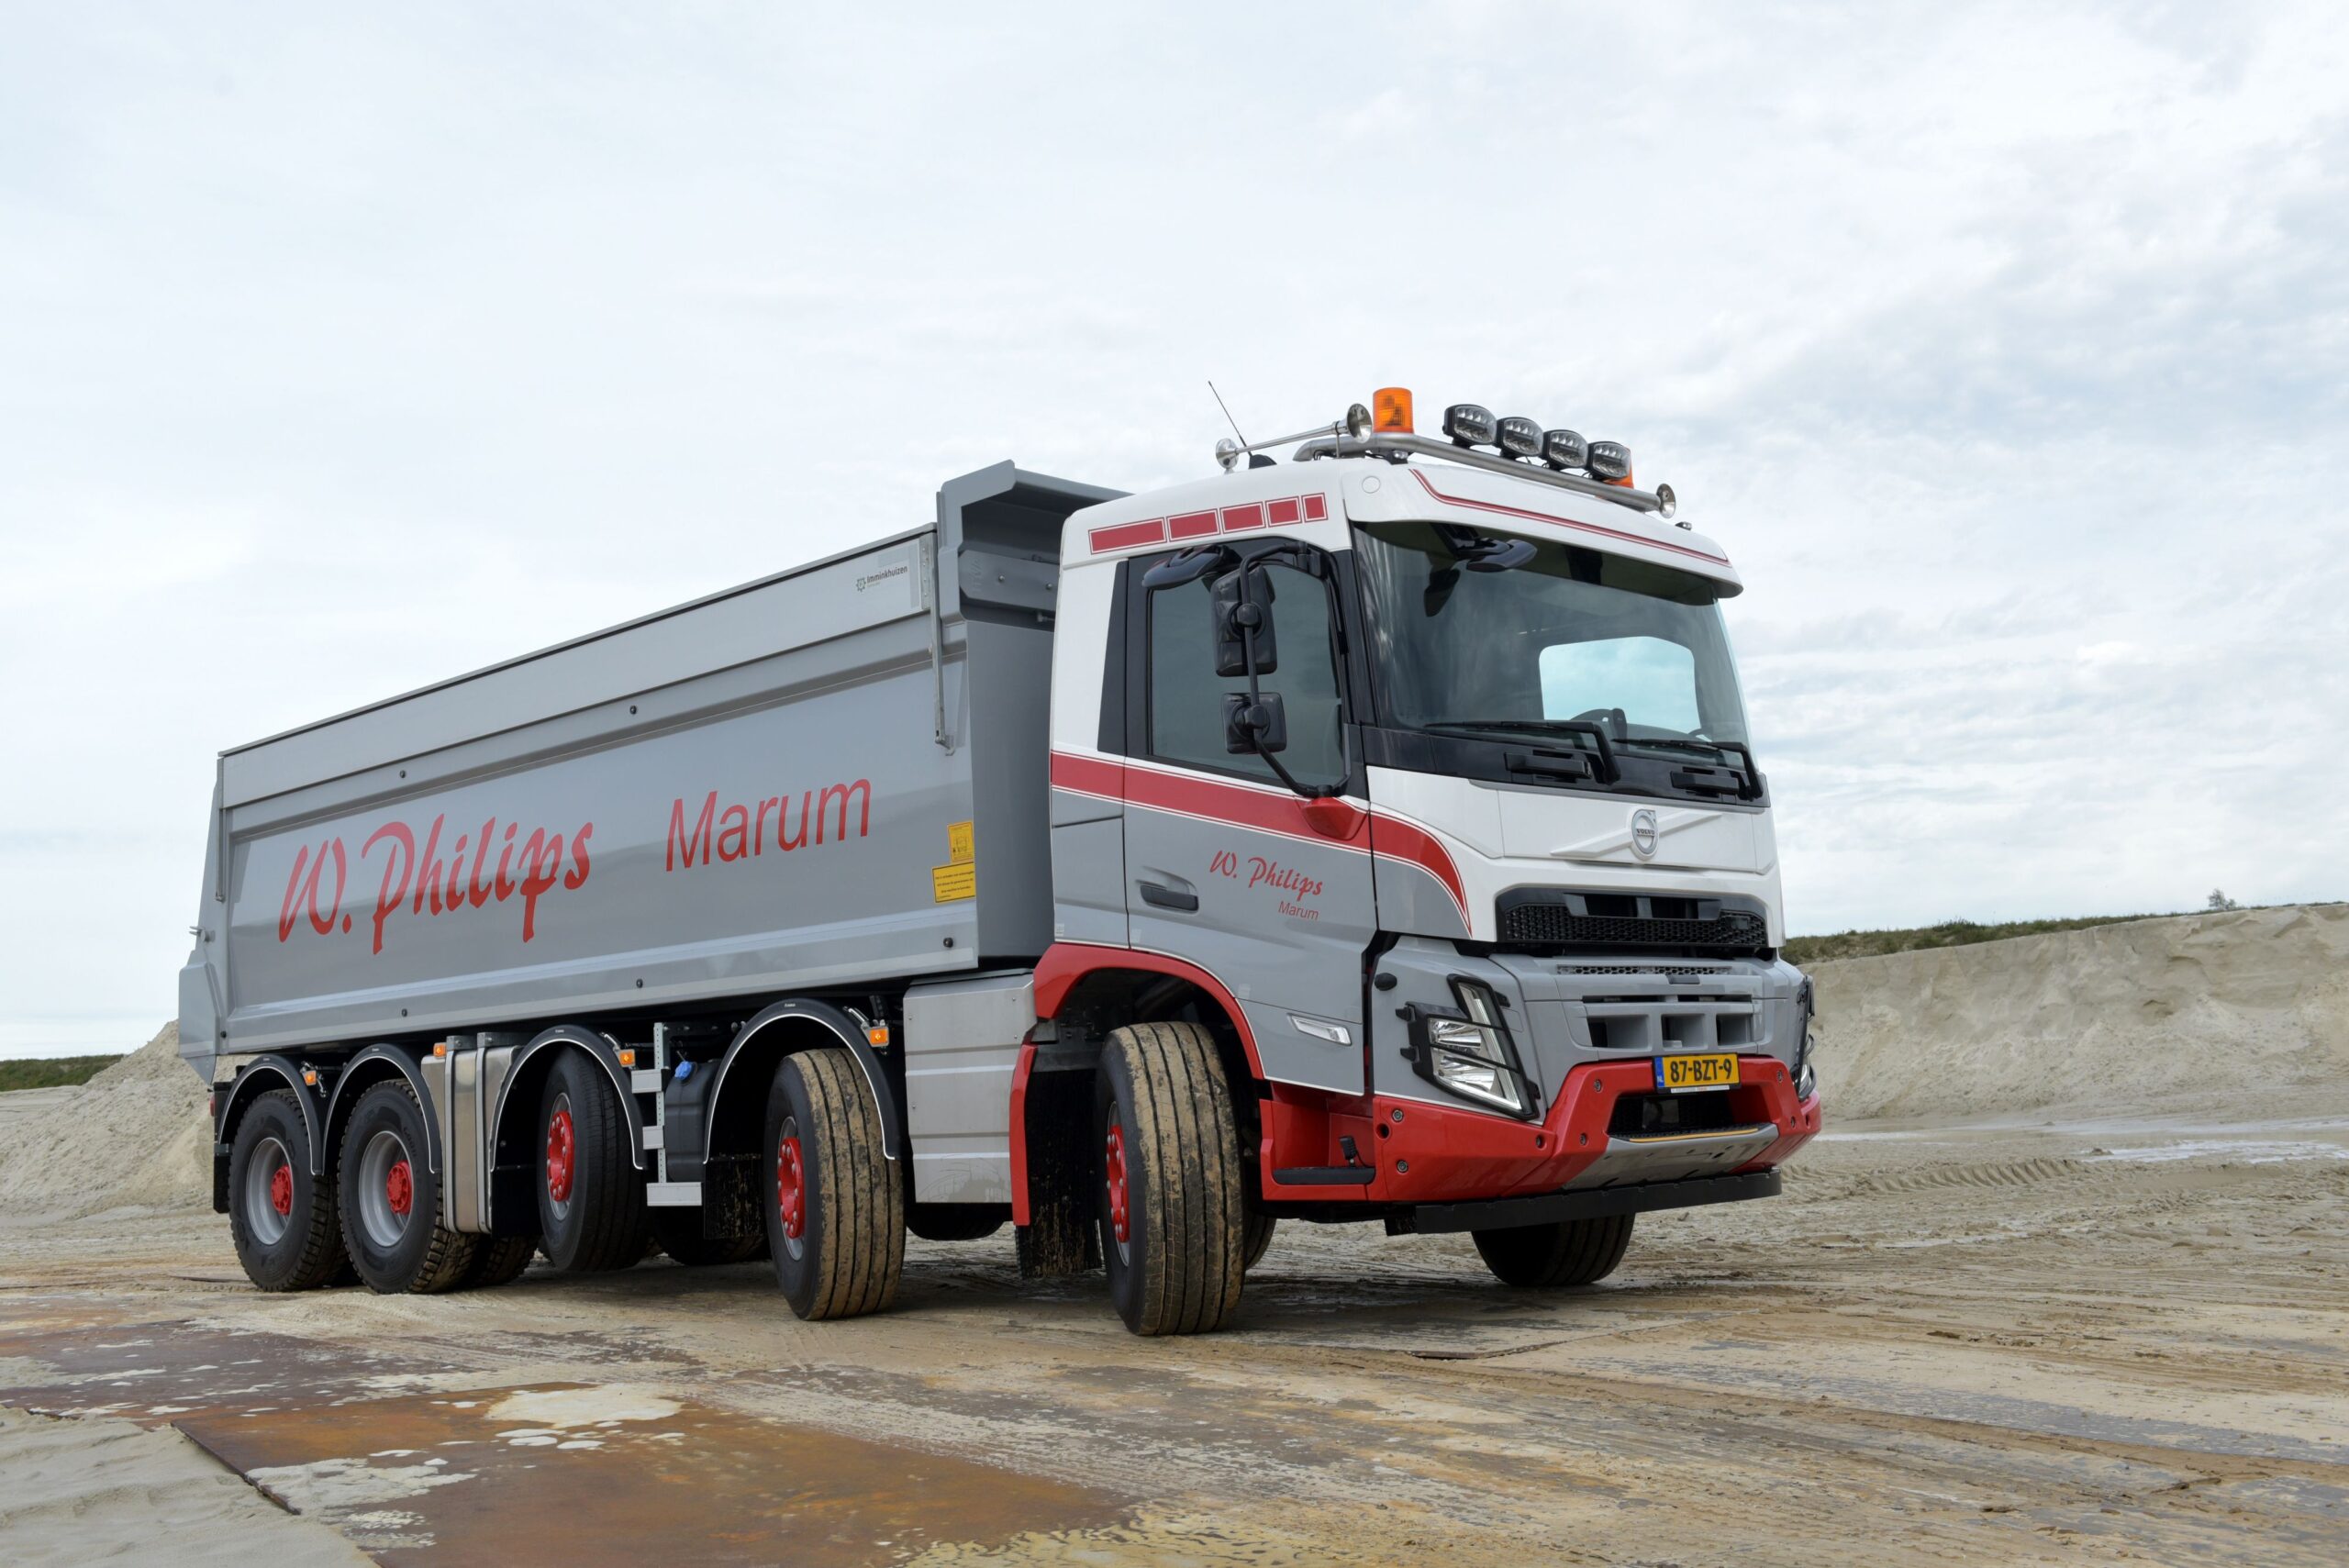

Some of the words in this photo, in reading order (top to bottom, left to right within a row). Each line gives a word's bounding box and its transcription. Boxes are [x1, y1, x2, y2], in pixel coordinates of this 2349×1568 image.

[279, 837, 351, 943] W.
[362, 813, 593, 955] Philips
[666, 779, 871, 873] Marum
[1209, 850, 1238, 878] W.
[1248, 857, 1323, 901] Philips
[1278, 900, 1319, 921] Marum
[1670, 1059, 1732, 1083] 87-BZT-9
